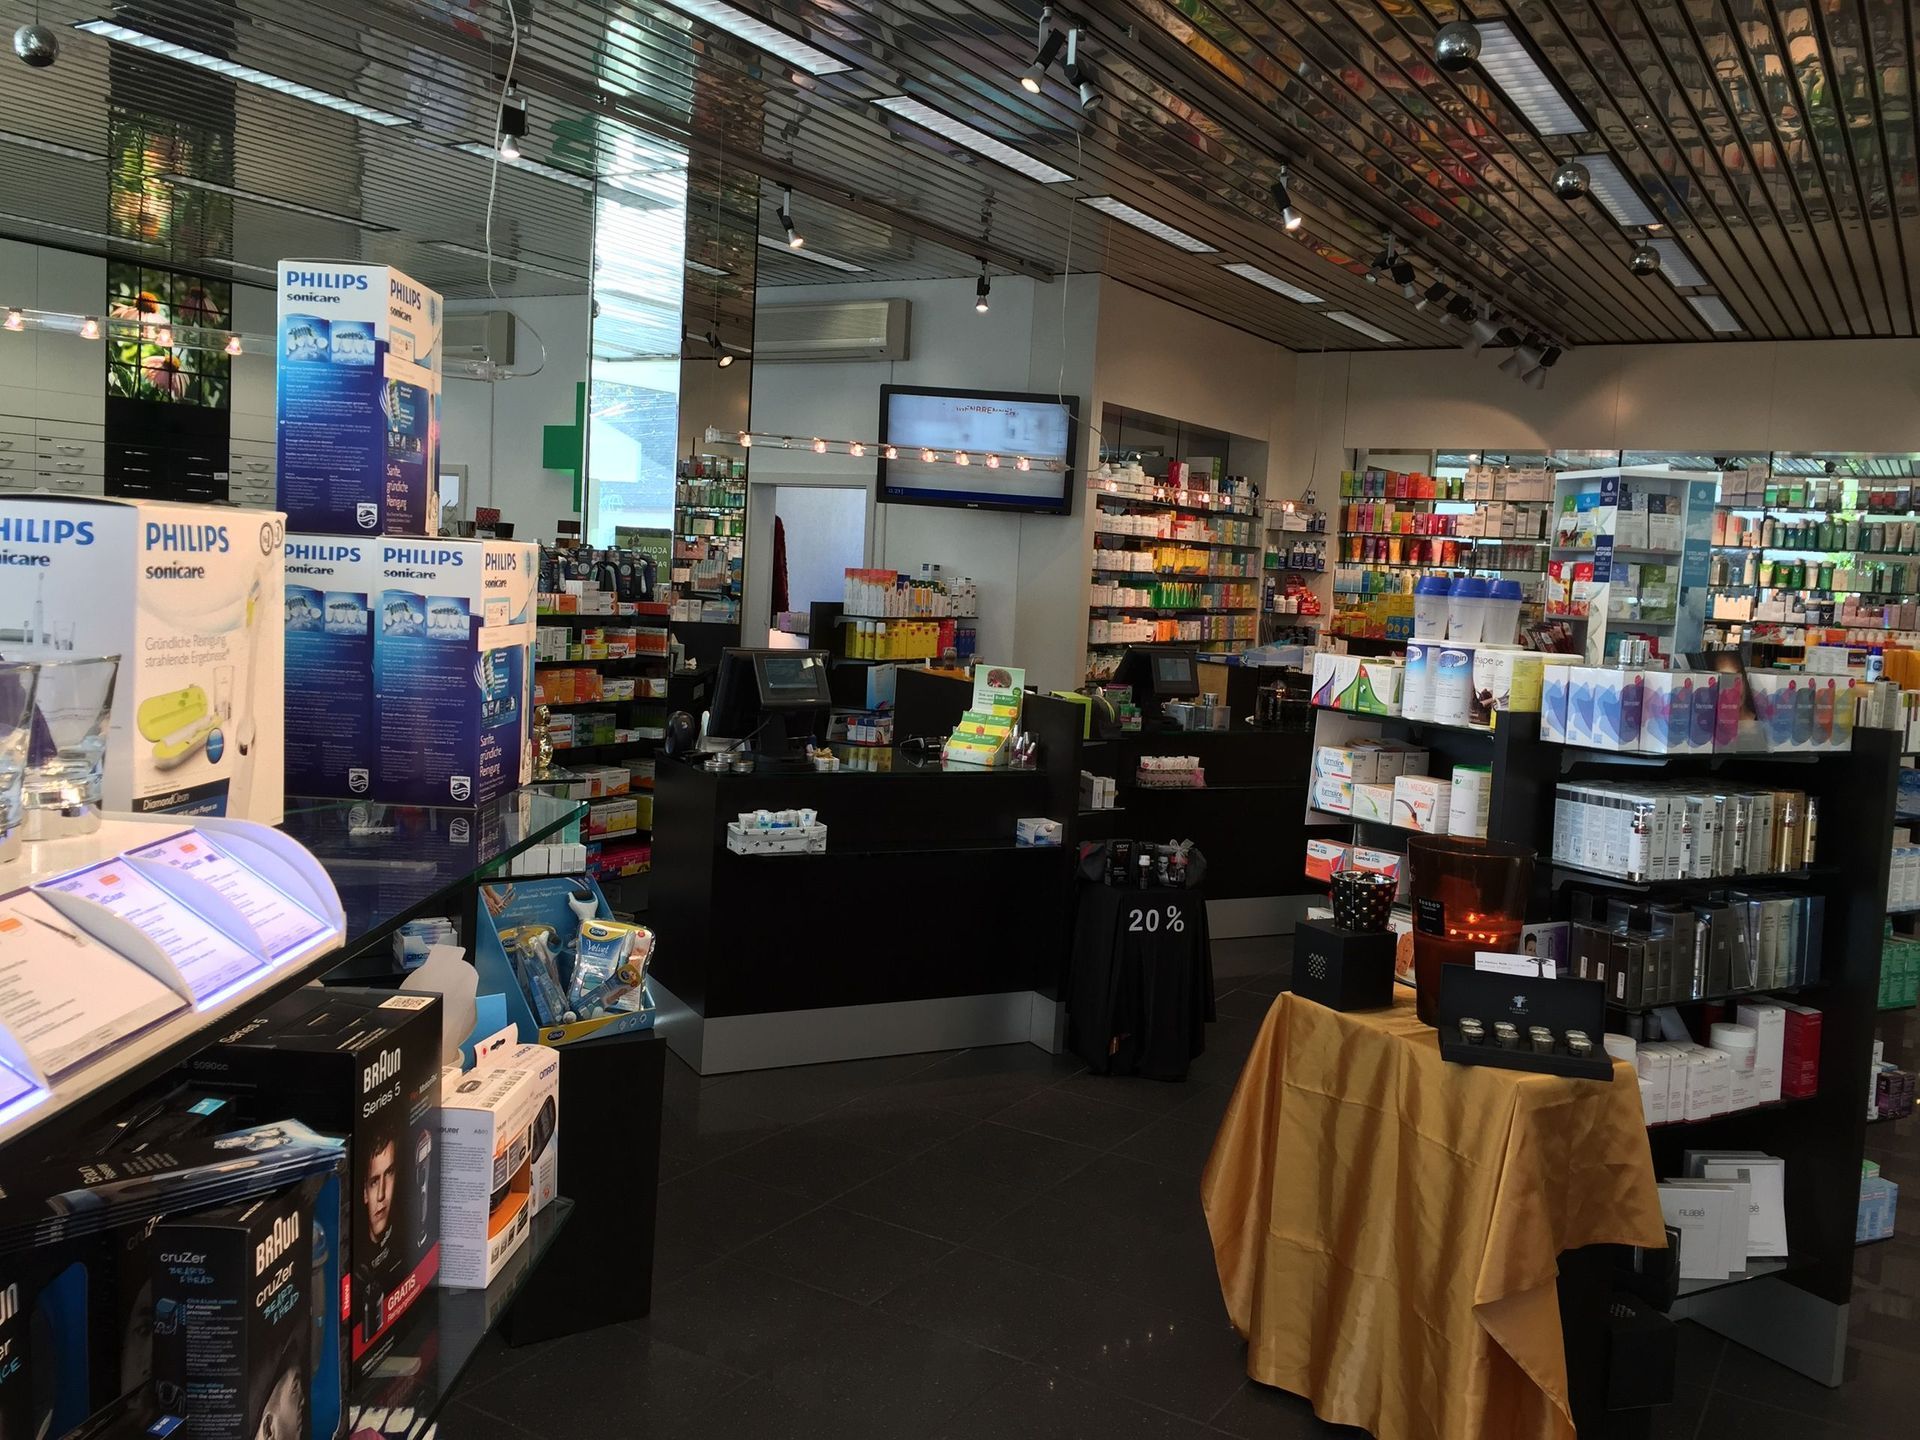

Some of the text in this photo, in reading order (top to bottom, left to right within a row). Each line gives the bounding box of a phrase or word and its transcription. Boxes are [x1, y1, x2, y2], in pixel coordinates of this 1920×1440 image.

[286, 271, 368, 290] PHILIPS
[286, 292, 340, 303] sonicare
[390, 279, 421, 310] PHILIPS
[390, 306, 412, 323] sonicare
[0, 518, 95, 545] HILIPS
[146, 522, 229, 552] PHILIPS
[0, 549, 50, 567] icare
[285, 544, 361, 562] PHILIPS
[384, 547, 463, 566] PHILIPS
[485, 552, 516, 571] PHILIPS
[146, 561, 205, 579] sonicare
[384, 567, 436, 580] sonicare
[485, 577, 507, 588] sonicare
[145, 637, 191, 651] Gründliche
[145, 653, 190, 667] strahlende
[1128, 905, 1185, 932] 20 %
[219, 1023, 258, 1044] Series
[363, 1048, 401, 1094] BRAUN
[362, 1081, 401, 1119] Series 5
[255, 1211, 299, 1277] BRAUN
[160, 1252, 207, 1264] cruZer
[256, 1261, 295, 1308] cruZer
[387, 1273, 416, 1311] GRATIS
[263, 1284, 294, 1319] BEARD
